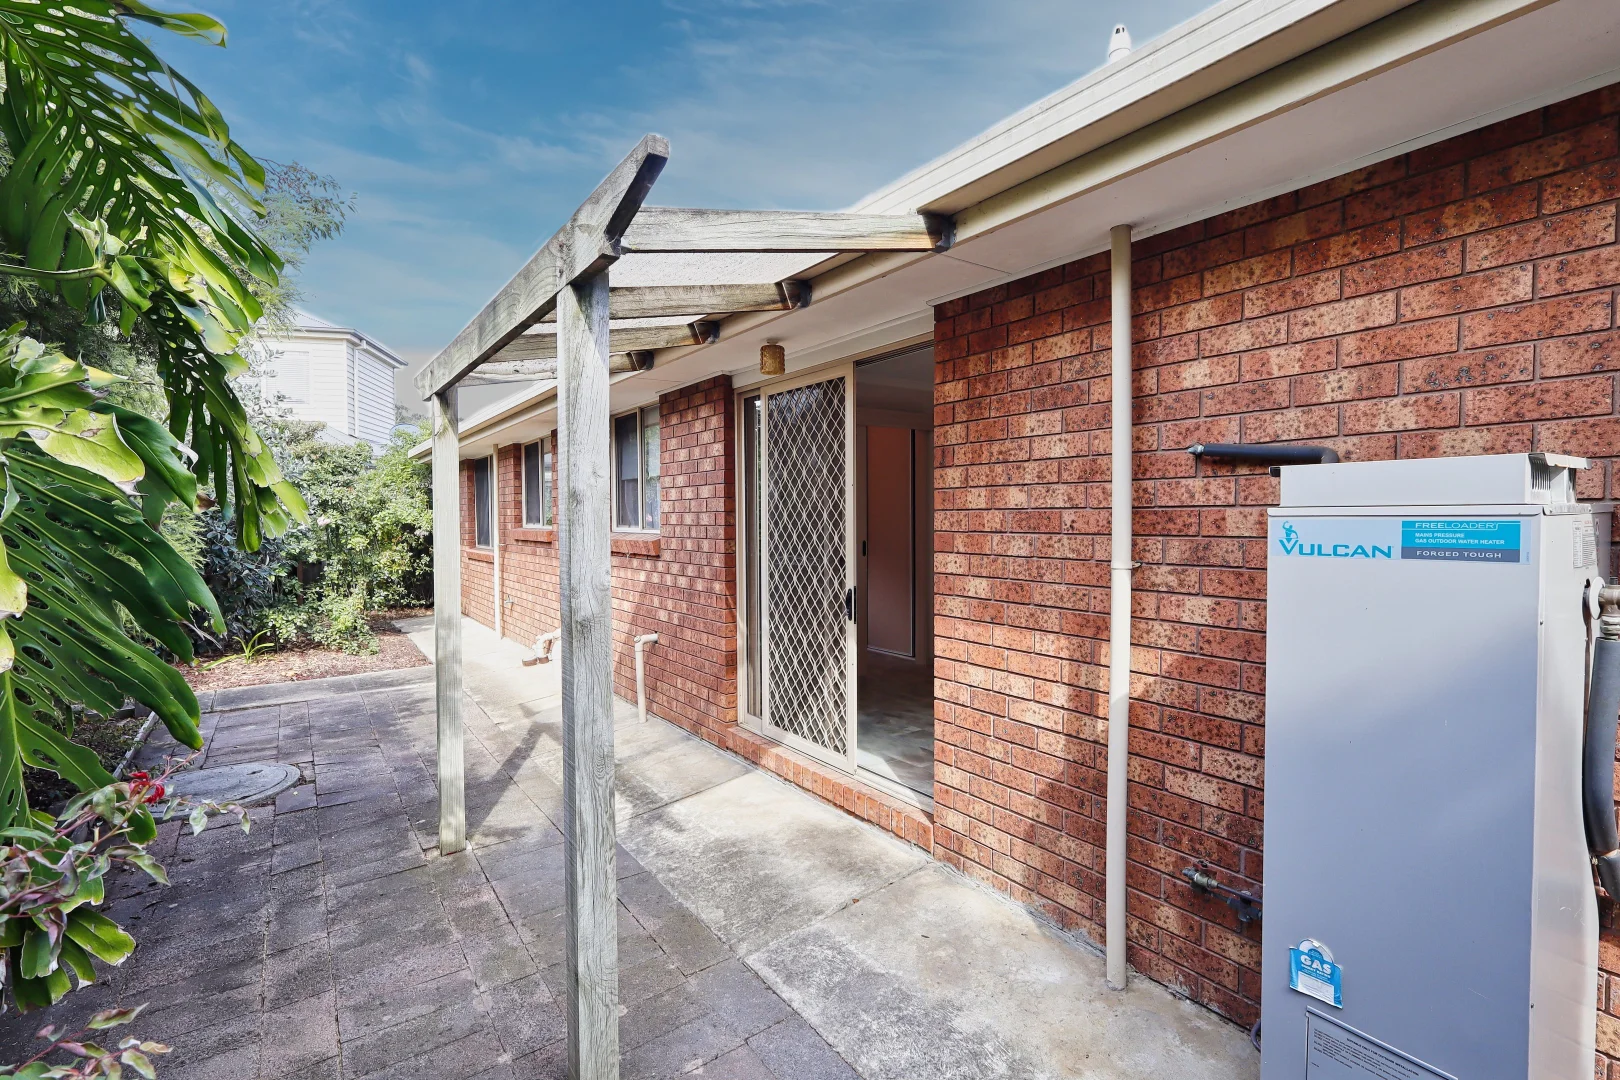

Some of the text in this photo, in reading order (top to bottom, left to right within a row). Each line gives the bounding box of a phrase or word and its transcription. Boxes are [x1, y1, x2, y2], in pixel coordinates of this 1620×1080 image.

[1415, 522, 1494, 530] FREELOADER
[1278, 538, 1392, 559] VULCAN
[1463, 551, 1502, 559] TOUGH
[1300, 954, 1332, 975] GAS
